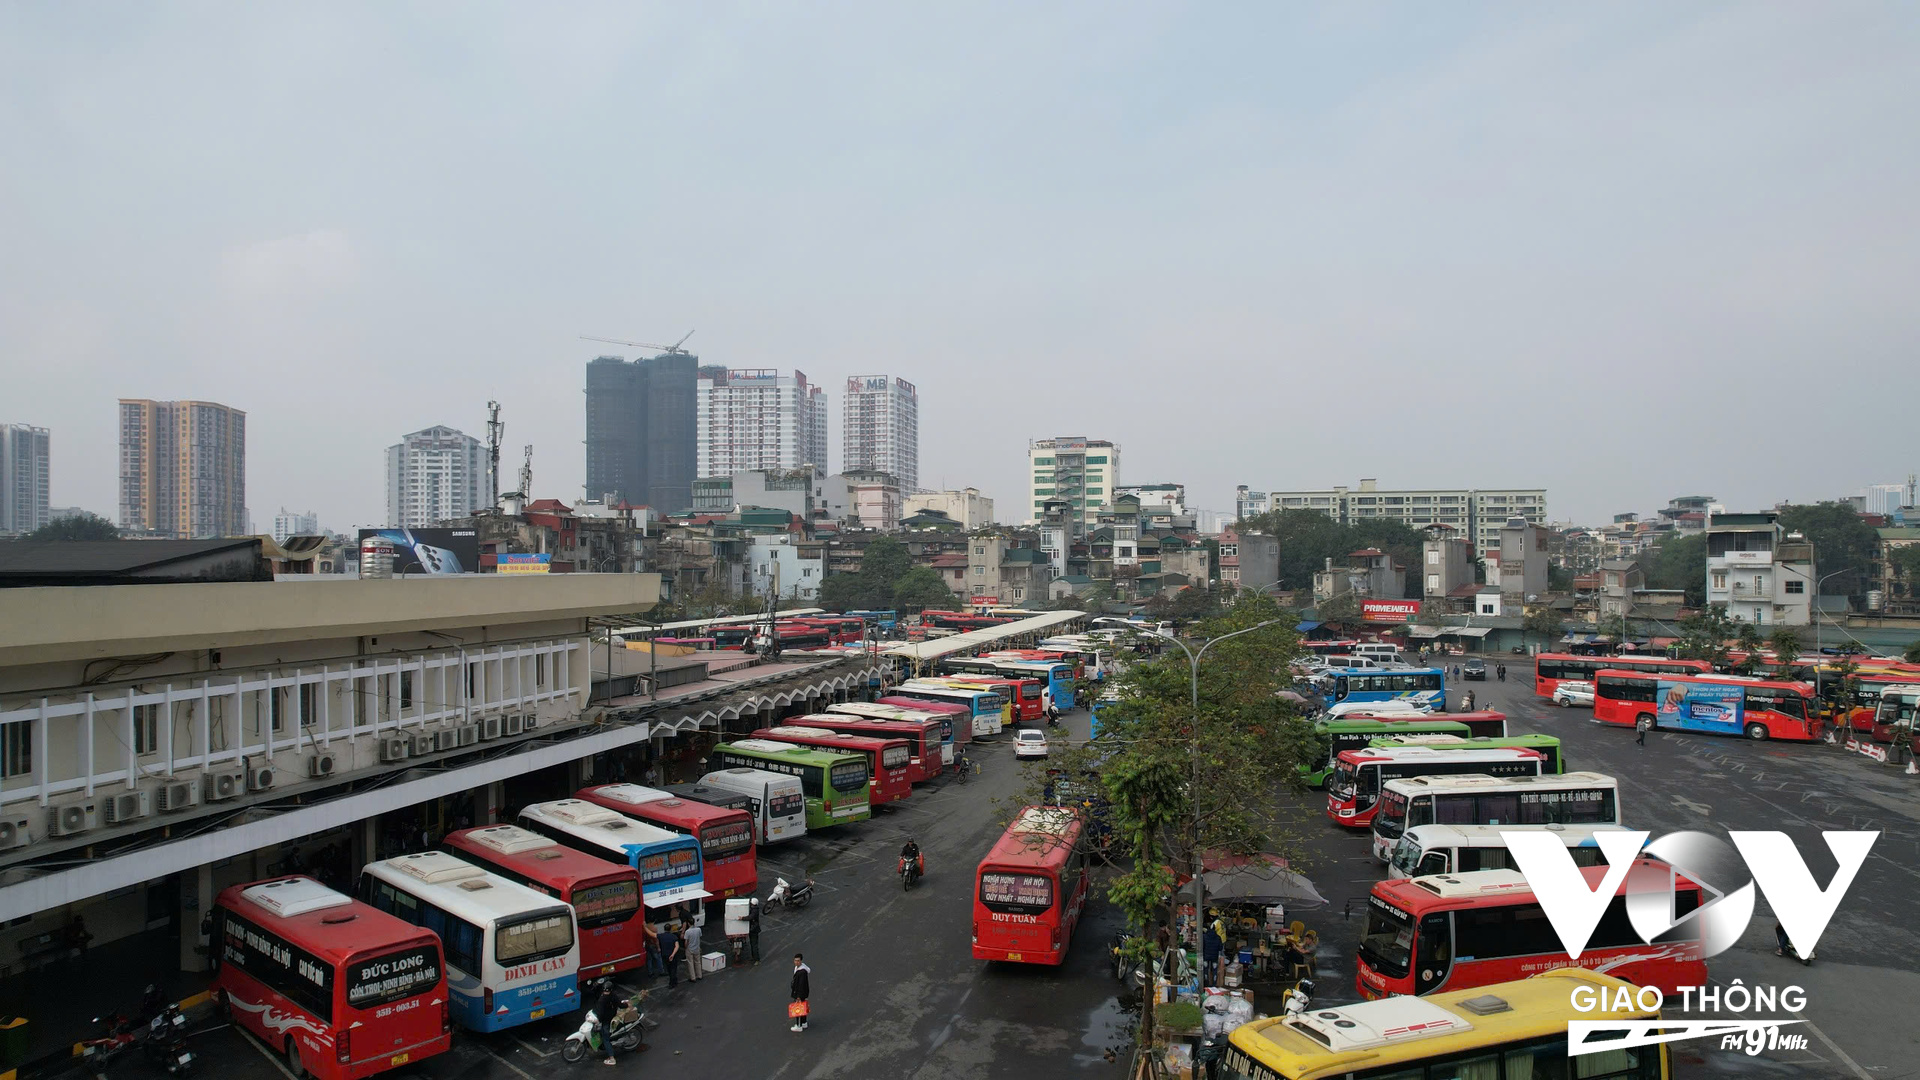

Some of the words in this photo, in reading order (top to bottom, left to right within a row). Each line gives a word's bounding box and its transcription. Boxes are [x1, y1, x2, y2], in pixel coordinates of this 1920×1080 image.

[867, 378, 887, 390] MB
[1363, 604, 1416, 613] PRIMEWELL
[992, 912, 1011, 923] DUY
[361, 962, 390, 981] ĐỨC
[392, 954, 425, 974] LONG
[382, 977, 399, 992] NINH
